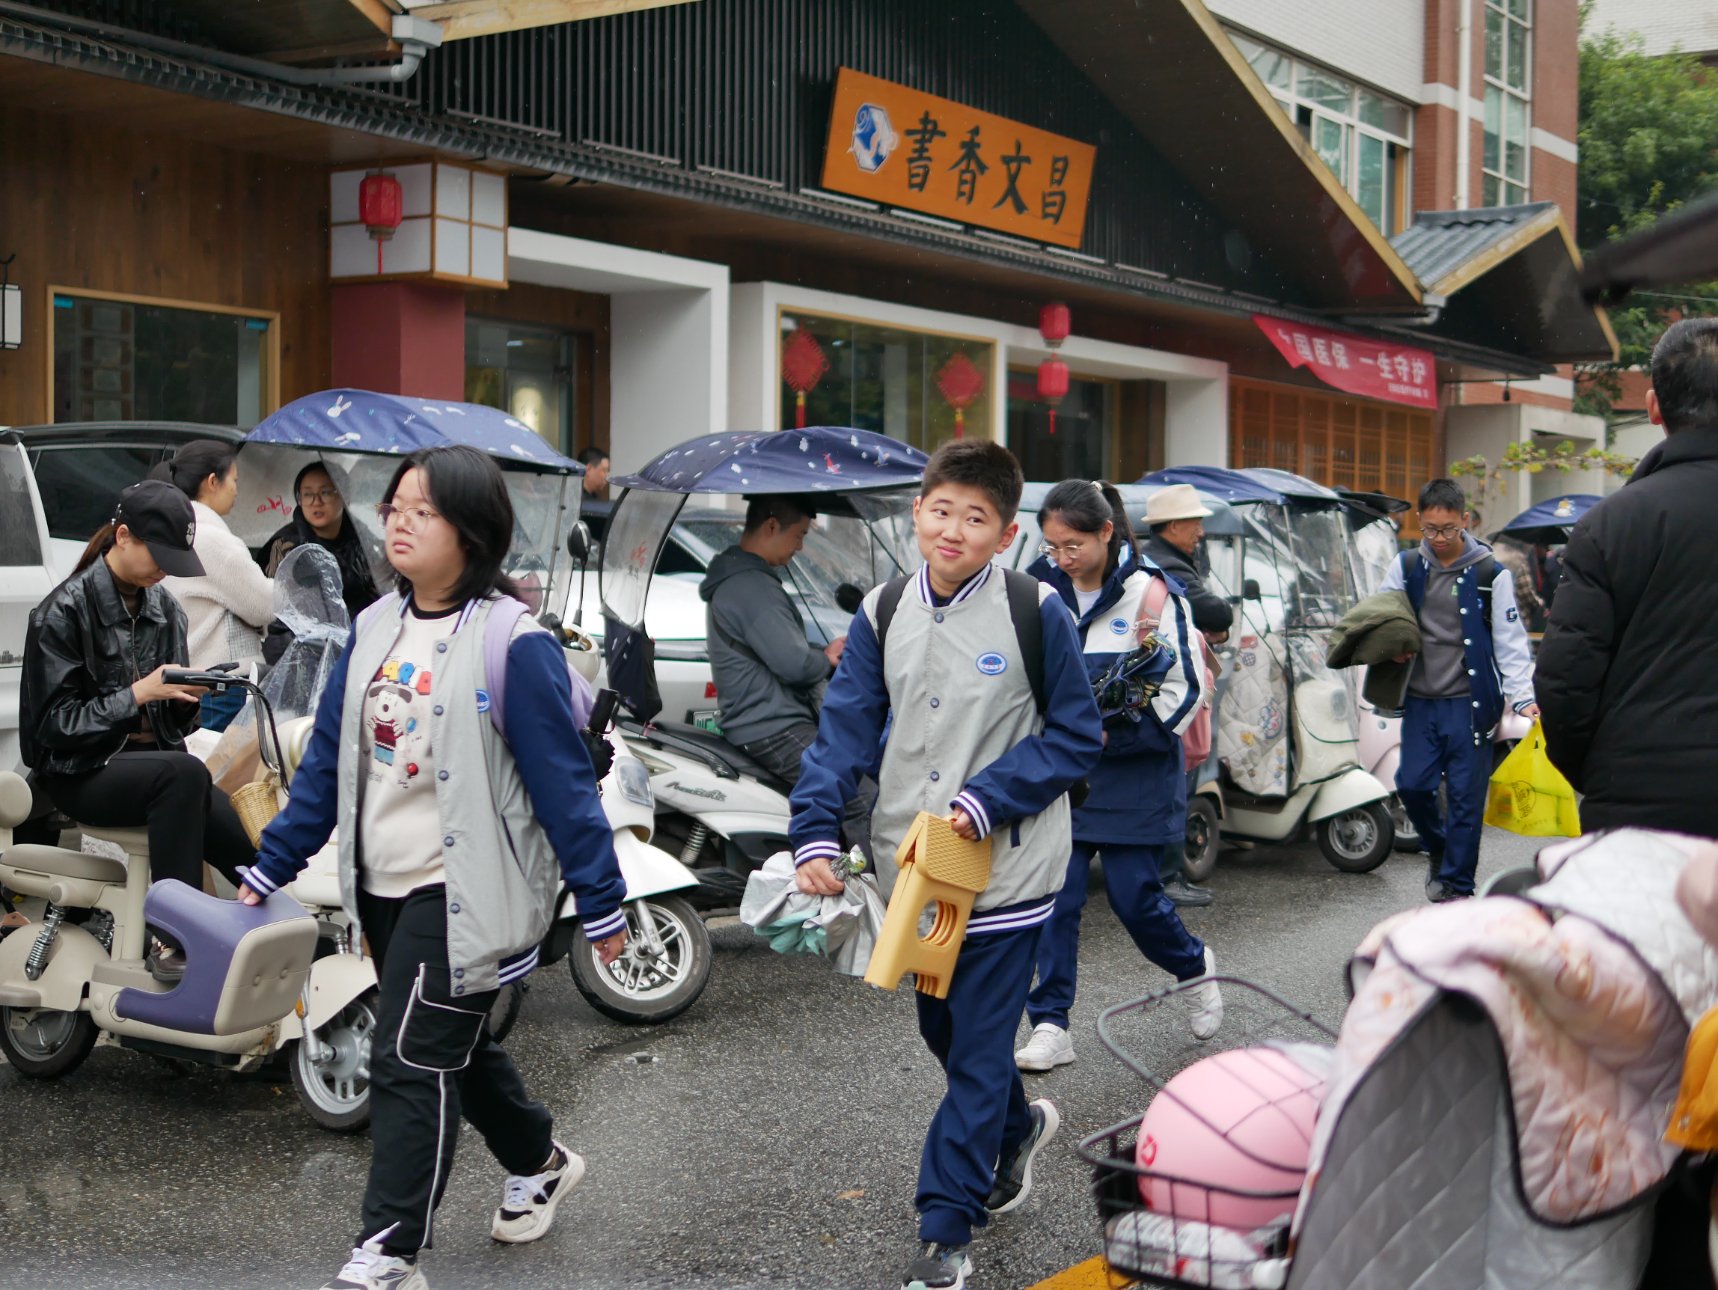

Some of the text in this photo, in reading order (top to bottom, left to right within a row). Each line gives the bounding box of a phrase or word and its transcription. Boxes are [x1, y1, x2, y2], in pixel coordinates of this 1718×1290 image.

[904, 110, 1069, 225] 書香文昌
[1359, 351, 1426, 384] 一生守护
